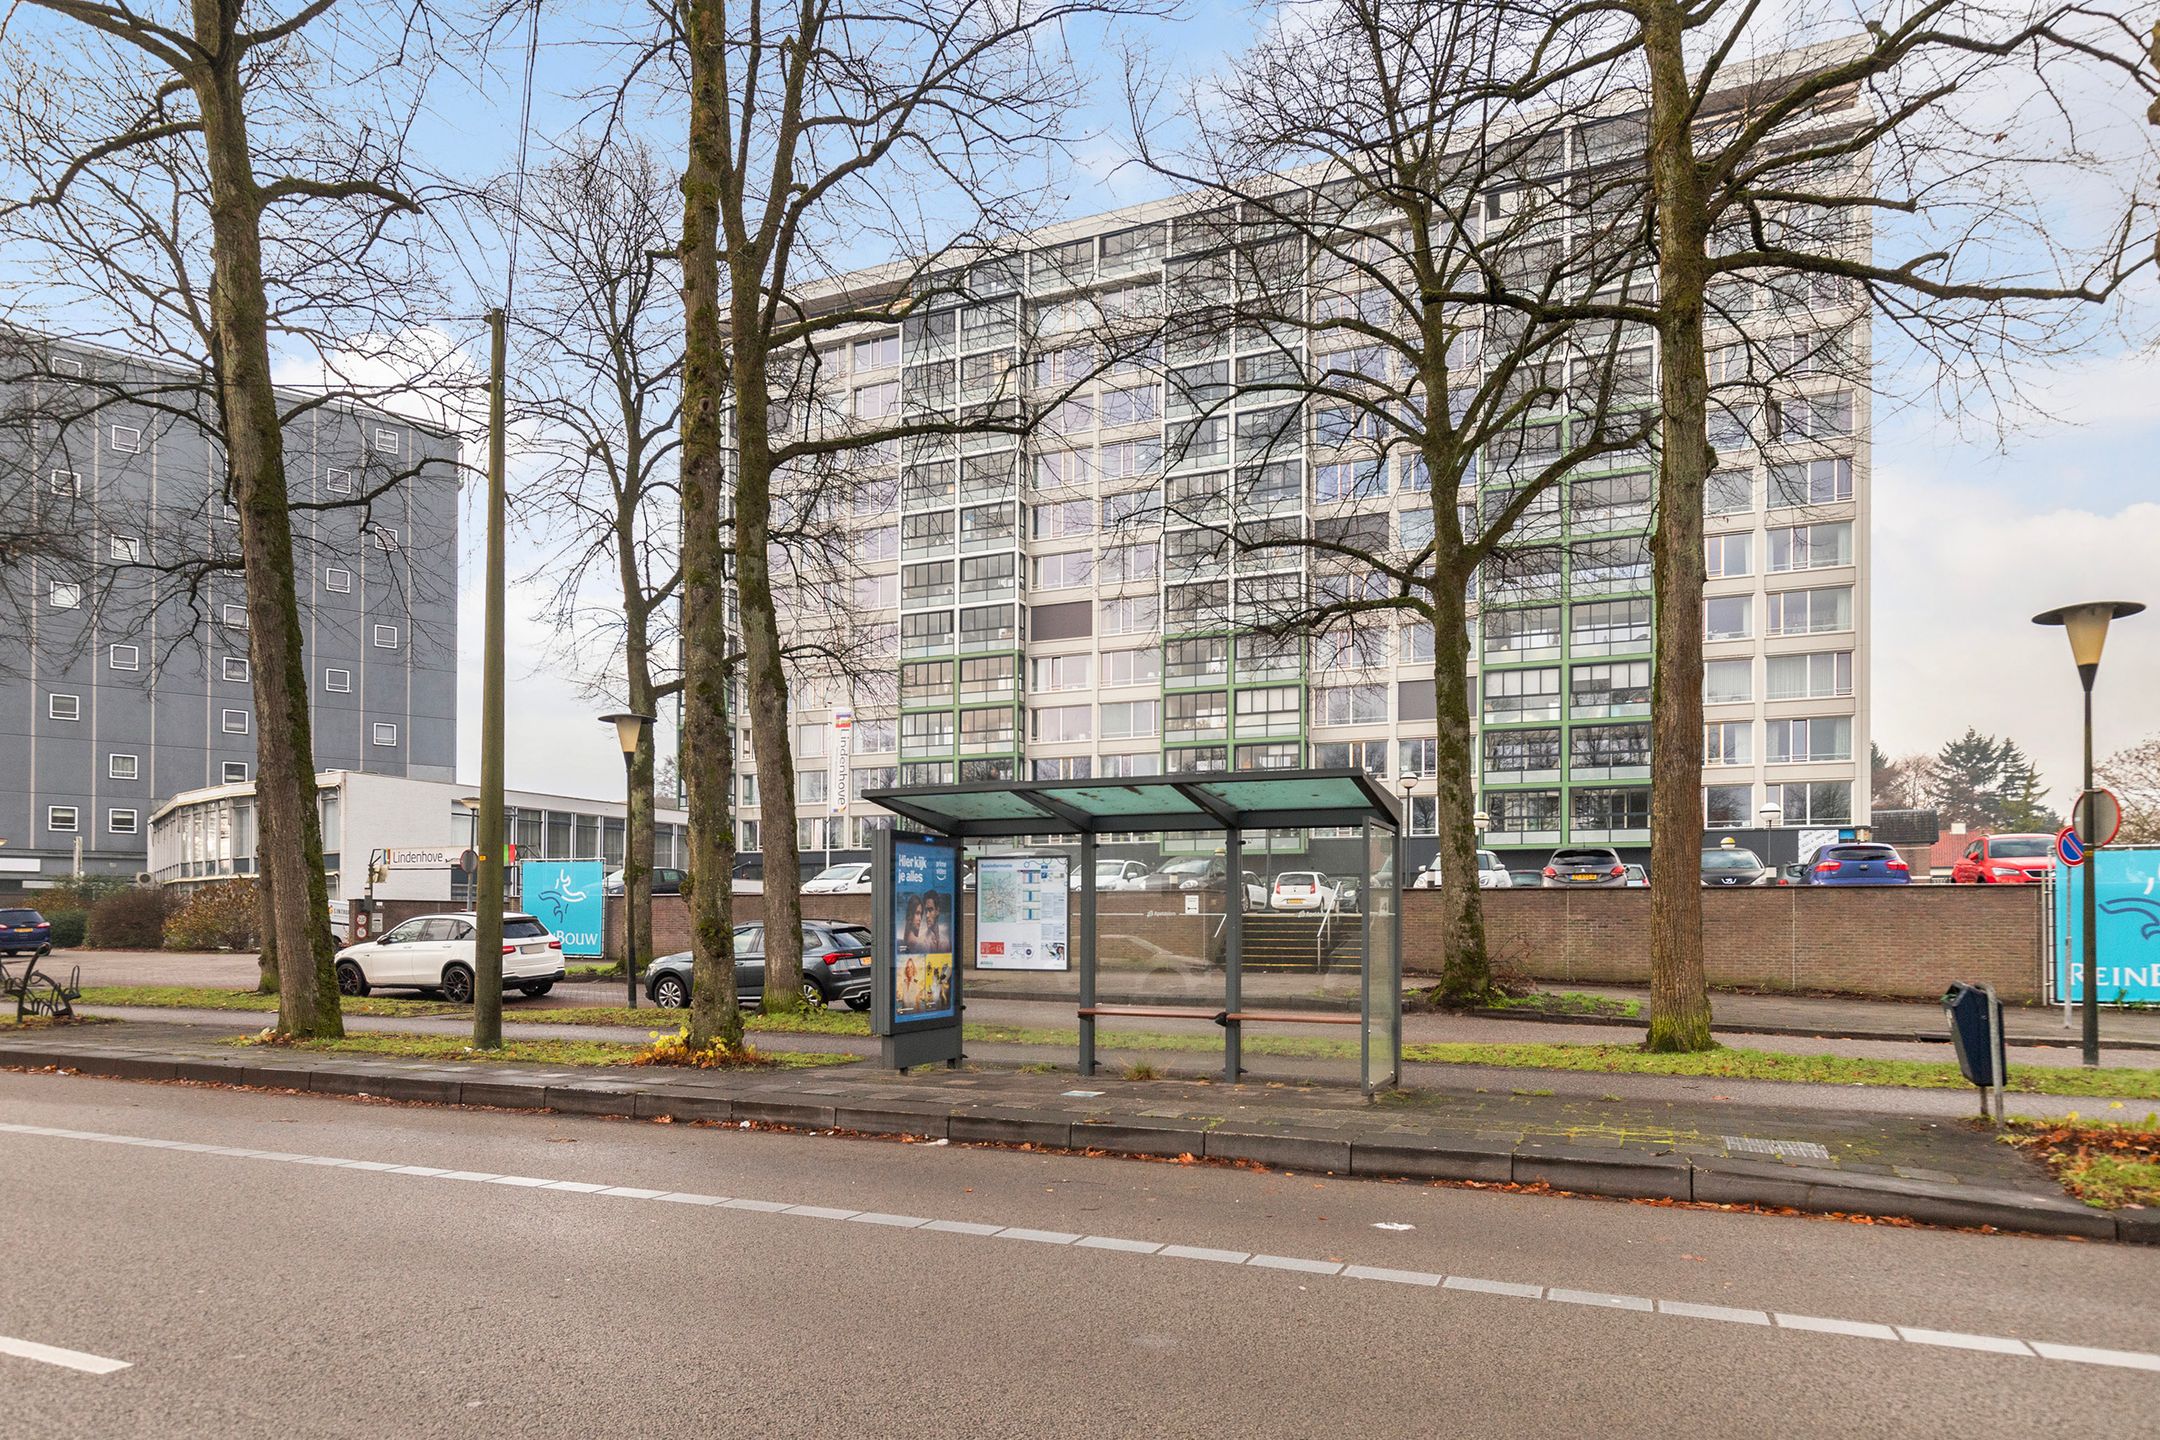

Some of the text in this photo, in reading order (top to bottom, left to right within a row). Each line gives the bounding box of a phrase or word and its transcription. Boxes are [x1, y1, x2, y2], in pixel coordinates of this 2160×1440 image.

[838, 728, 850, 806] Lindenhove
[393, 851, 443, 864] Lindenhove
[898, 854, 927, 870] Hier kijk
[898, 869, 923, 884] je alles
[553, 930, 598, 945] BOUW
